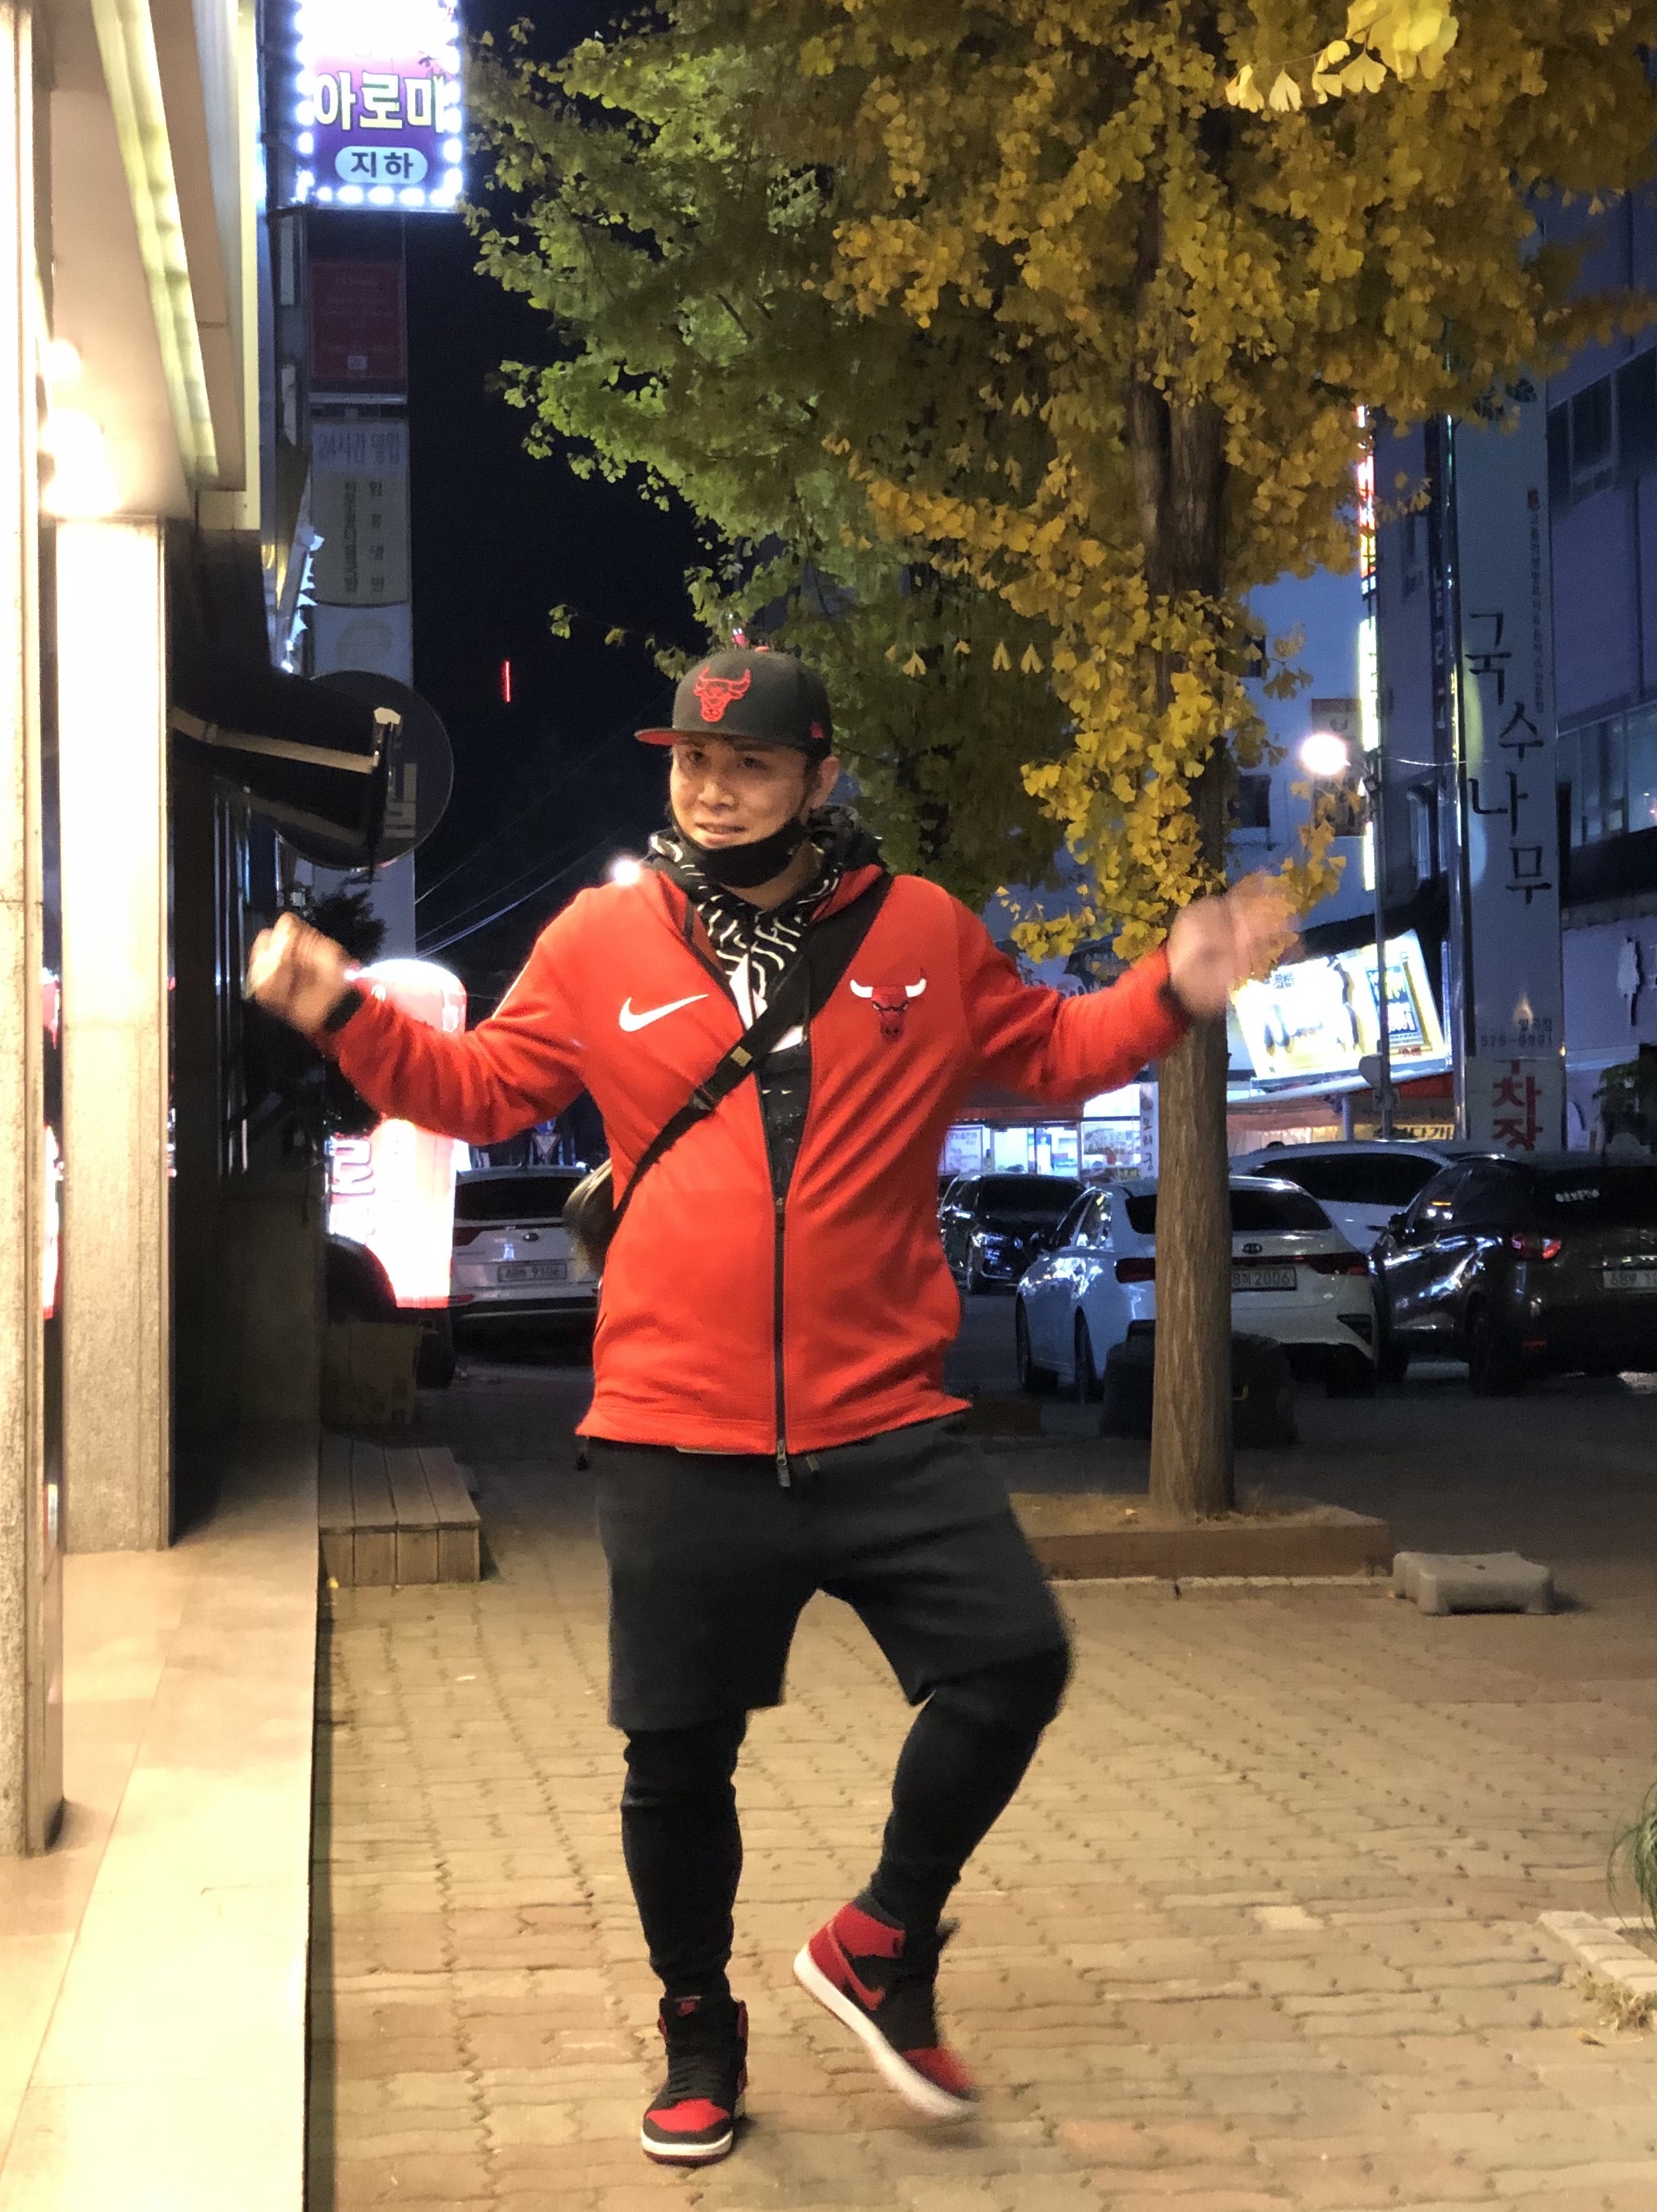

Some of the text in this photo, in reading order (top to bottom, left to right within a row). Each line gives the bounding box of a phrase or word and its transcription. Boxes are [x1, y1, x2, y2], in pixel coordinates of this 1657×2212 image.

[351, 152, 413, 179] 지하
[1464, 611, 1552, 905] 국수나무
[1492, 1060, 1543, 1151] 차장
